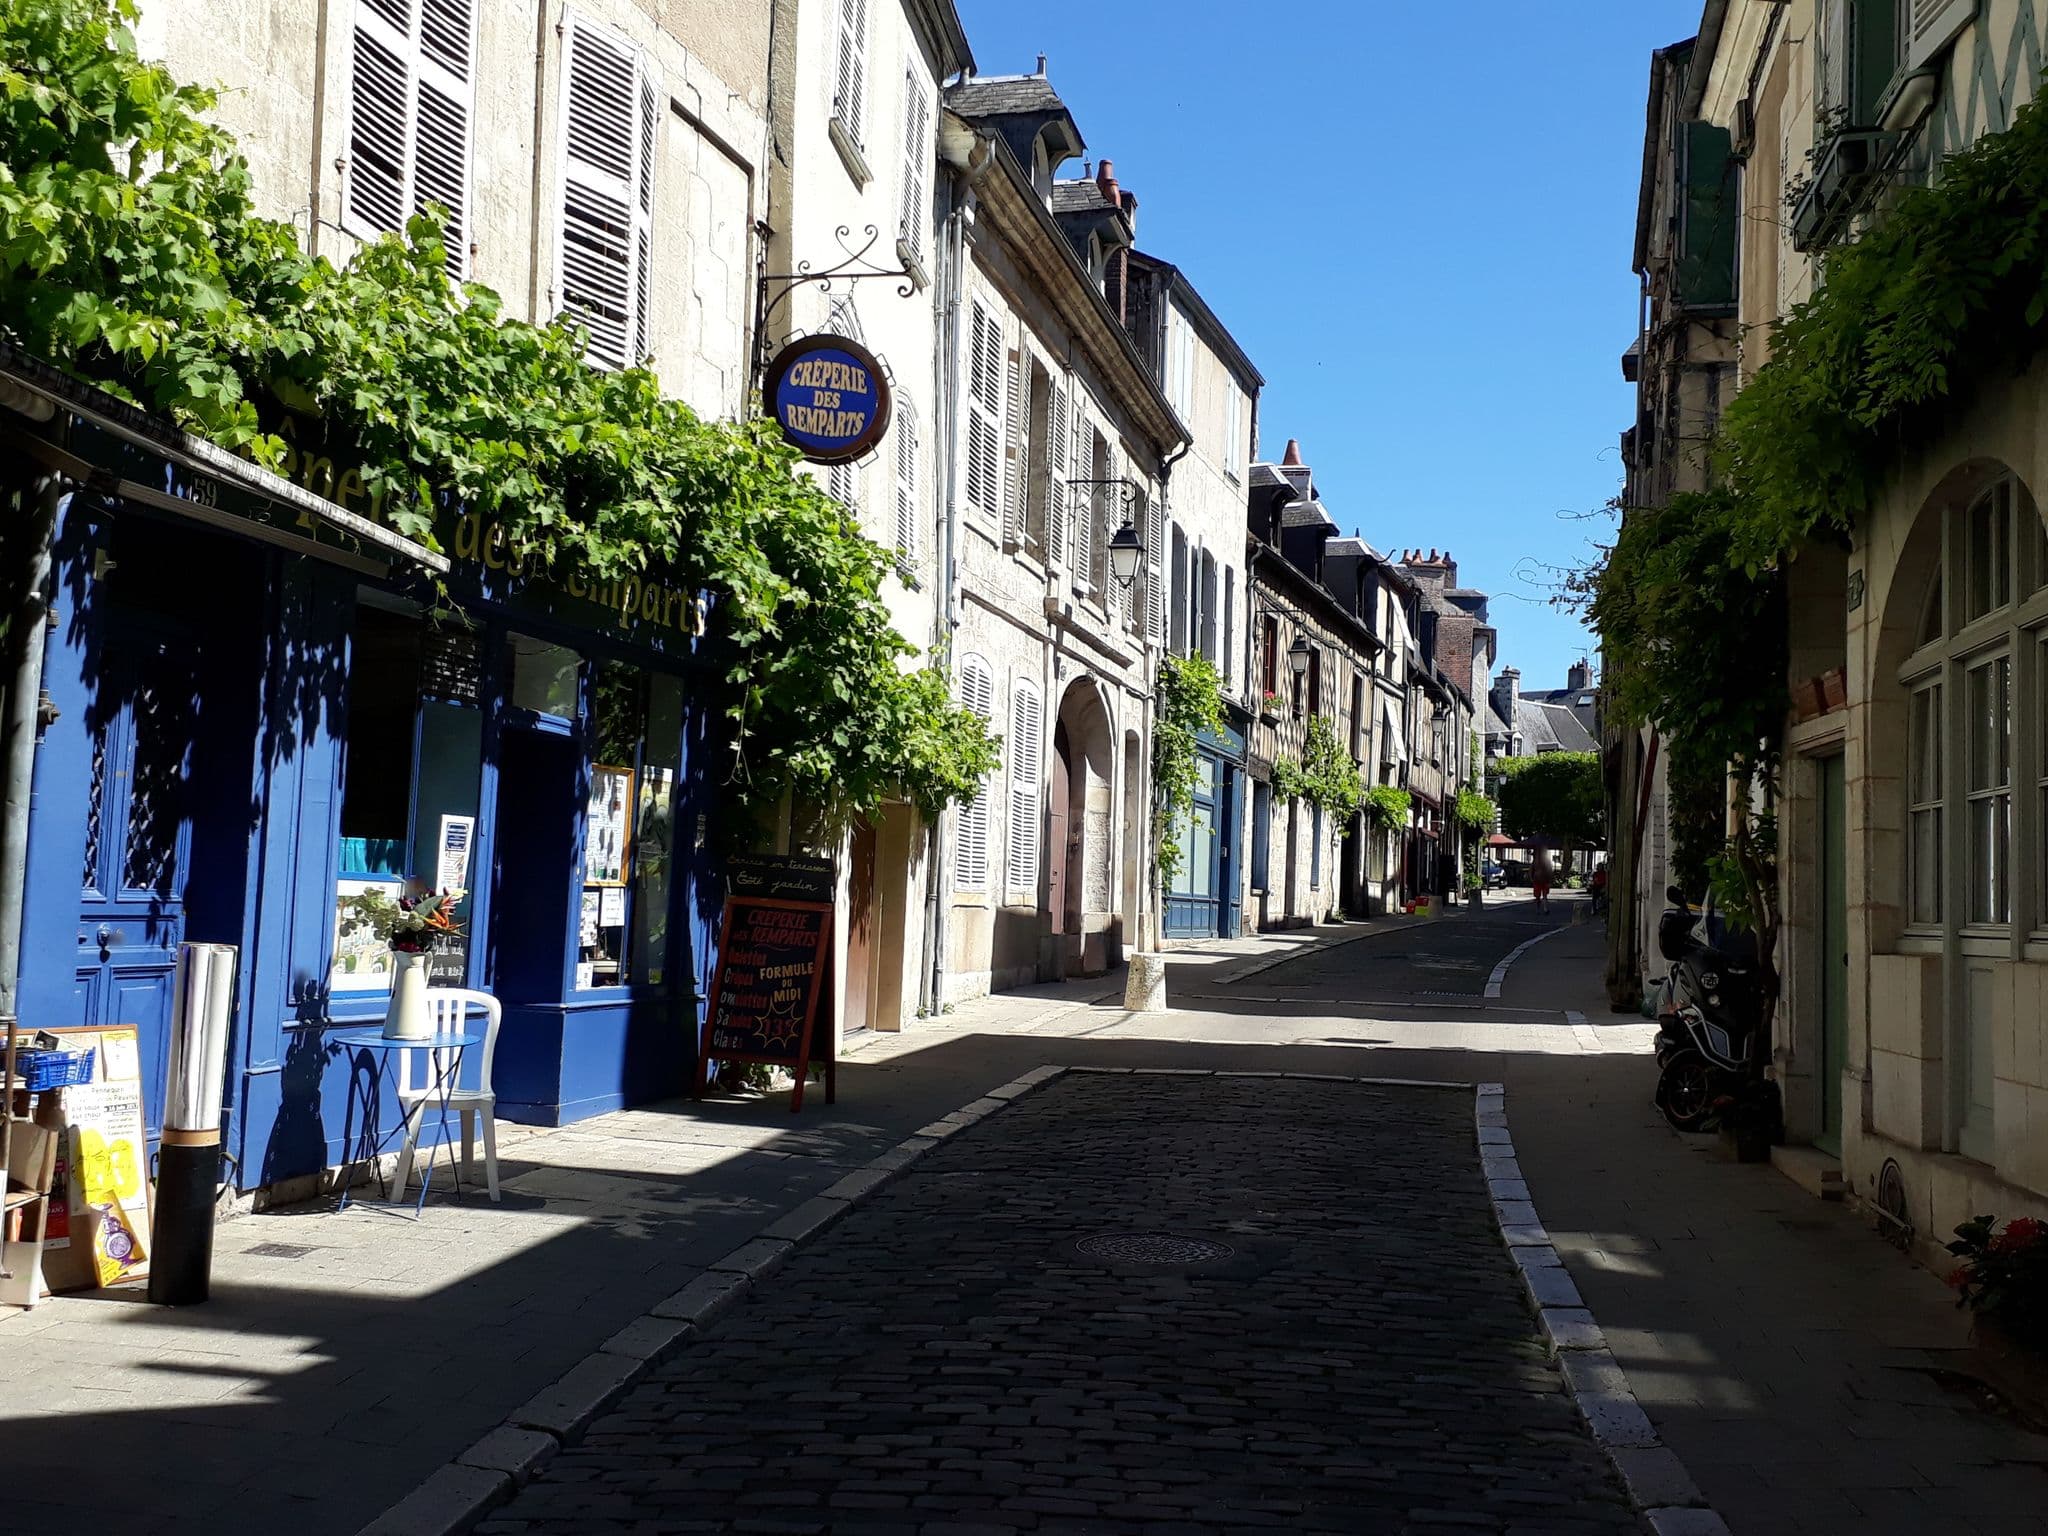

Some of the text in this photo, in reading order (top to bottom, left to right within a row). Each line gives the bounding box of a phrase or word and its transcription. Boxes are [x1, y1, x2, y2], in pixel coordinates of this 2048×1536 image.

[790, 358, 867, 394] CRÊPERIE
[813, 390, 841, 409] DES
[786, 404, 865, 438] REMPARTS
[193, 477, 217, 507] 59
[770, 879, 818, 895] jardin
[750, 926, 818, 946] REMPARTS
[760, 961, 815, 980] FORMULE
[782, 979, 793, 988] DU
[773, 988, 801, 1003] MIDI
